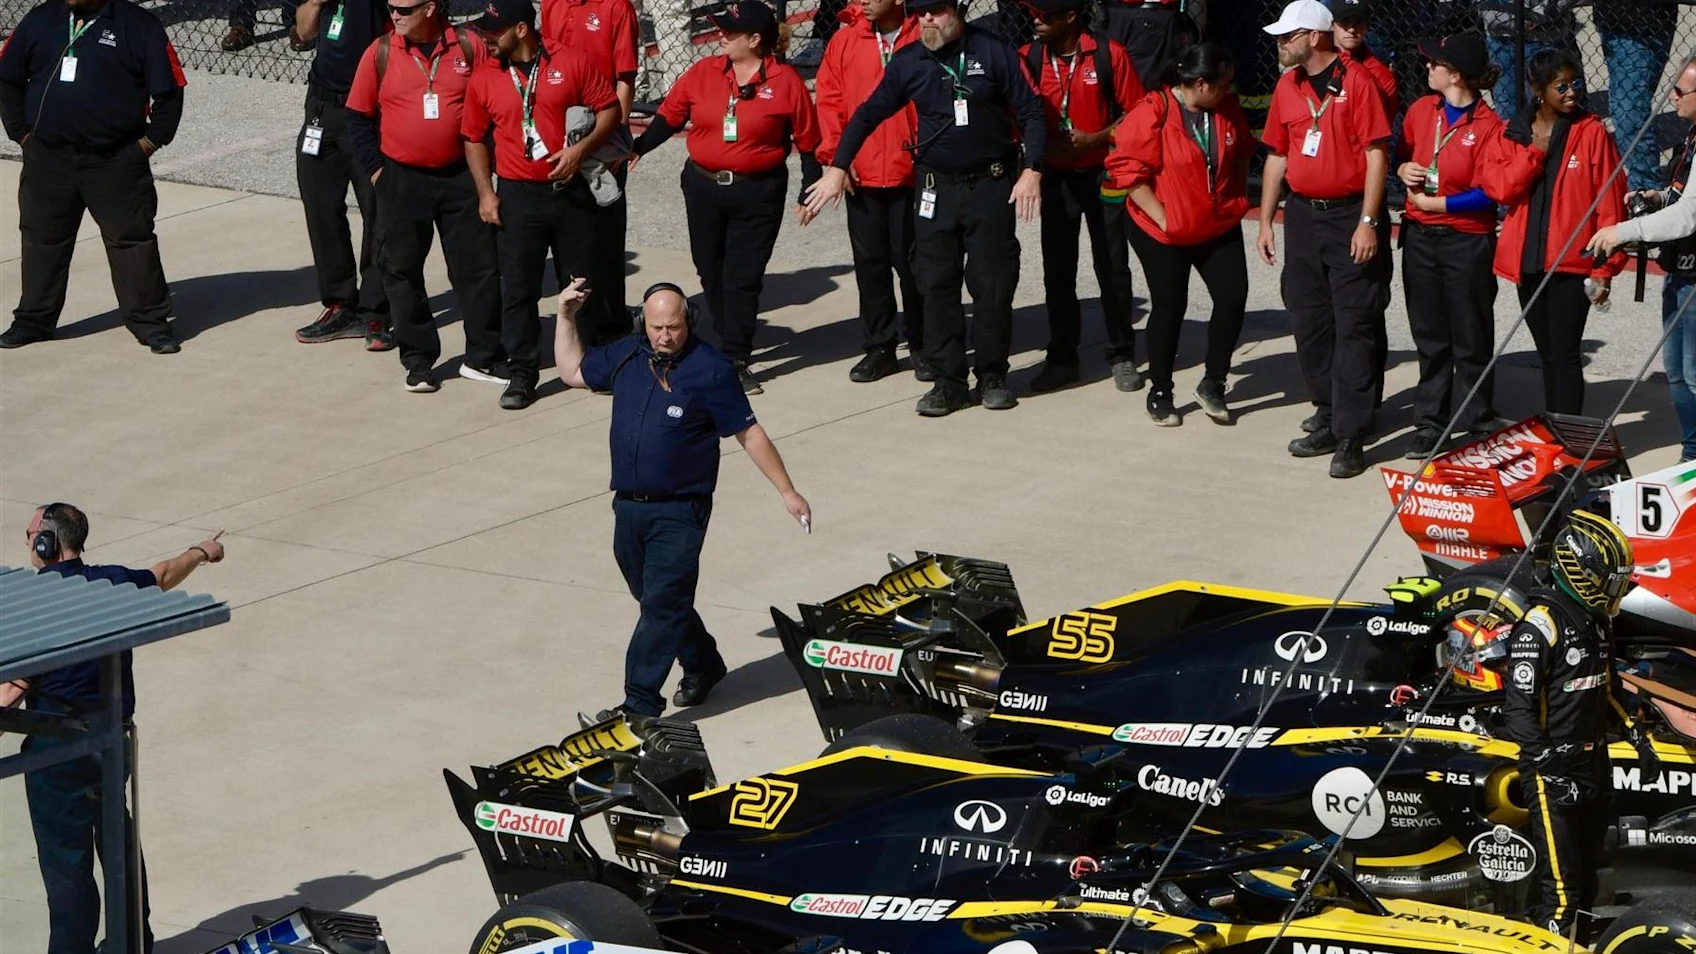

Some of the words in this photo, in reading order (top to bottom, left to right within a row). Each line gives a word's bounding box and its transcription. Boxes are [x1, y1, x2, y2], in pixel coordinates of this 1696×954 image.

[1383, 471, 1459, 498] V-Power
[1418, 496, 1475, 512] MISSION
[1641, 486, 1663, 533] 5
[1436, 543, 1488, 560] MAHLE
[1047, 610, 1121, 664] 55
[1388, 620, 1431, 634] LaLiga
[825, 644, 895, 673] Castrol
[1241, 668, 1355, 696] INFINITI
[1129, 725, 1188, 745] Castrol
[1186, 723, 1281, 748] EDGE
[1138, 764, 1226, 807] Canel's
[1387, 790, 1423, 804] BANK
[729, 776, 799, 830] 27
[1067, 790, 1109, 807] LaLiga
[1389, 805, 1418, 817] AND
[498, 807, 566, 838] Castrol
[919, 836, 1033, 868] INFINITI
[1477, 840, 1528, 858] Estrella
[1479, 854, 1526, 872] Galicia
[1431, 871, 1468, 883] HECHTER
[1079, 882, 1130, 902] ultimate
[807, 895, 866, 915] Castrol
[860, 895, 958, 921] EDGE
